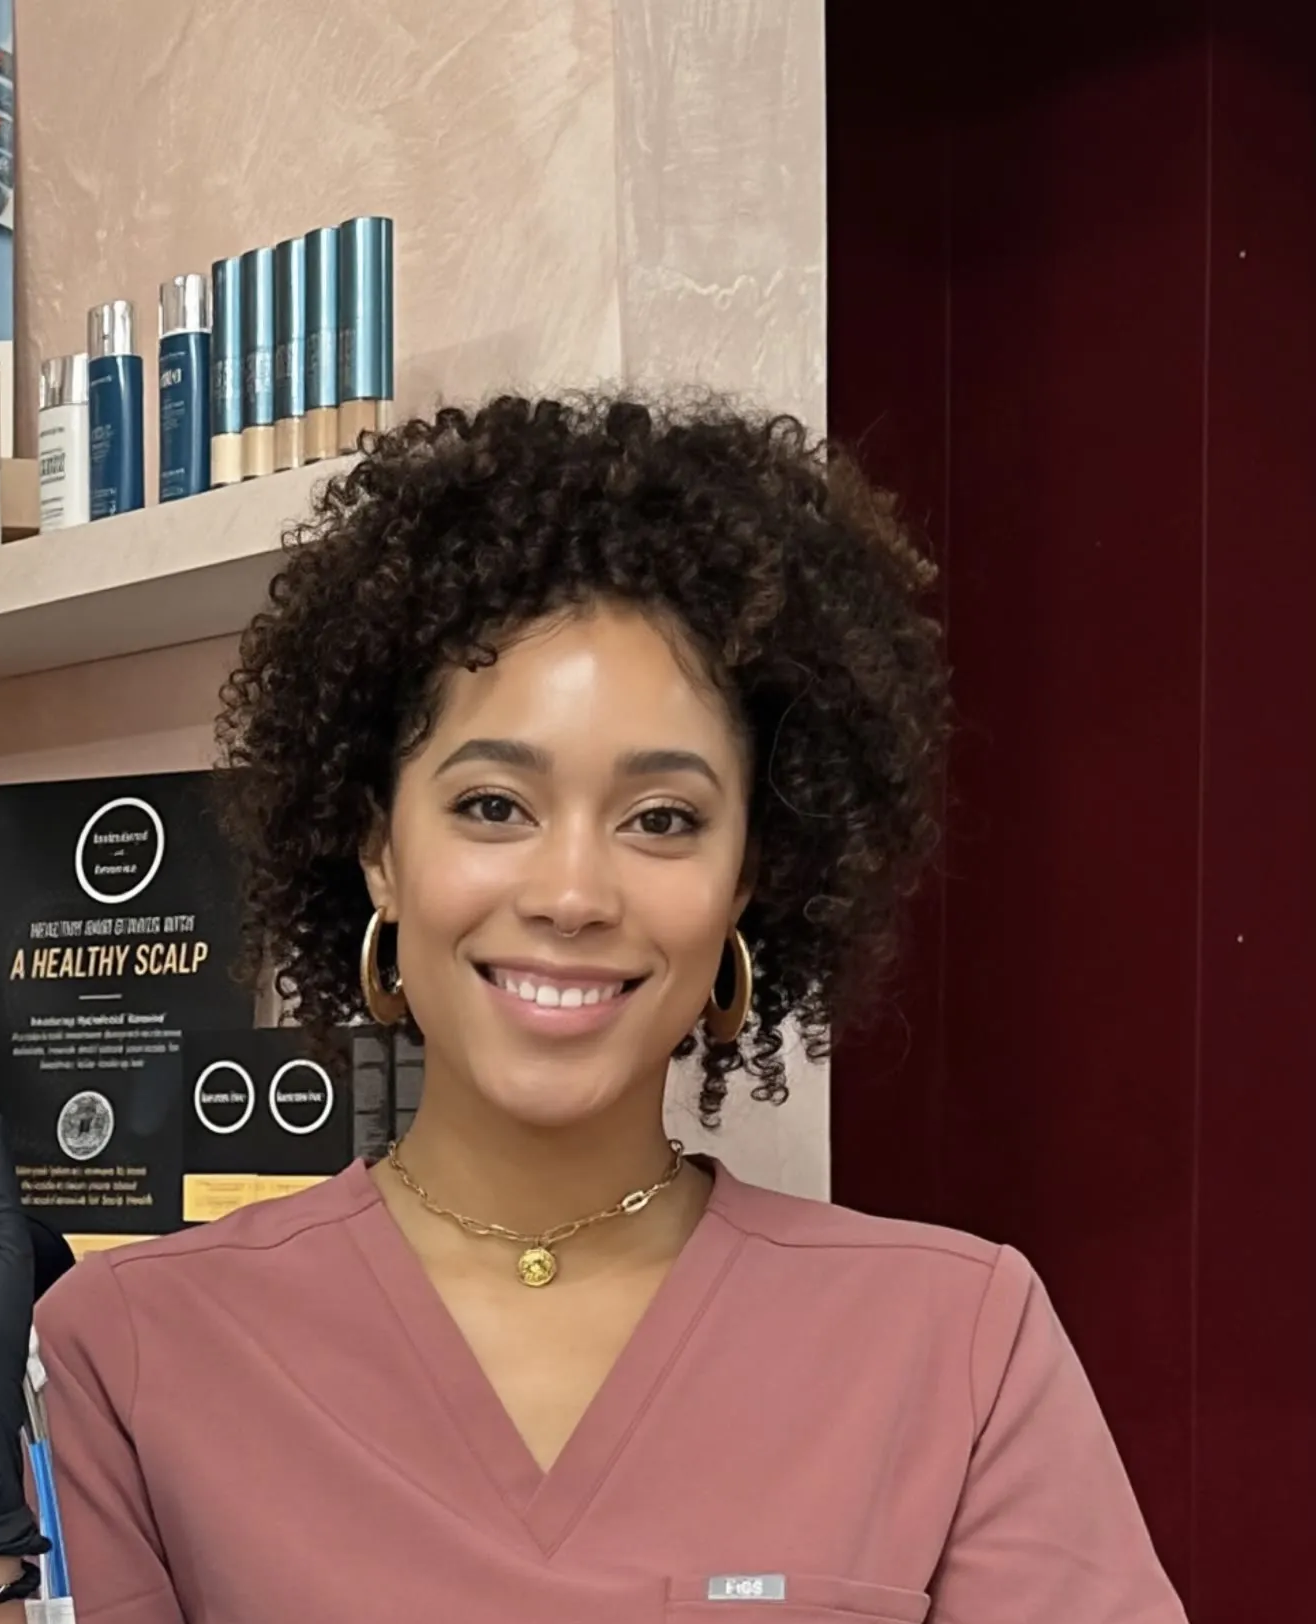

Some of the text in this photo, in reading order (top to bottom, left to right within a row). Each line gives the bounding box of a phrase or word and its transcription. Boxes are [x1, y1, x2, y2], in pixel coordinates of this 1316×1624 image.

[10, 941, 209, 981] A HEALTHY SCALP
